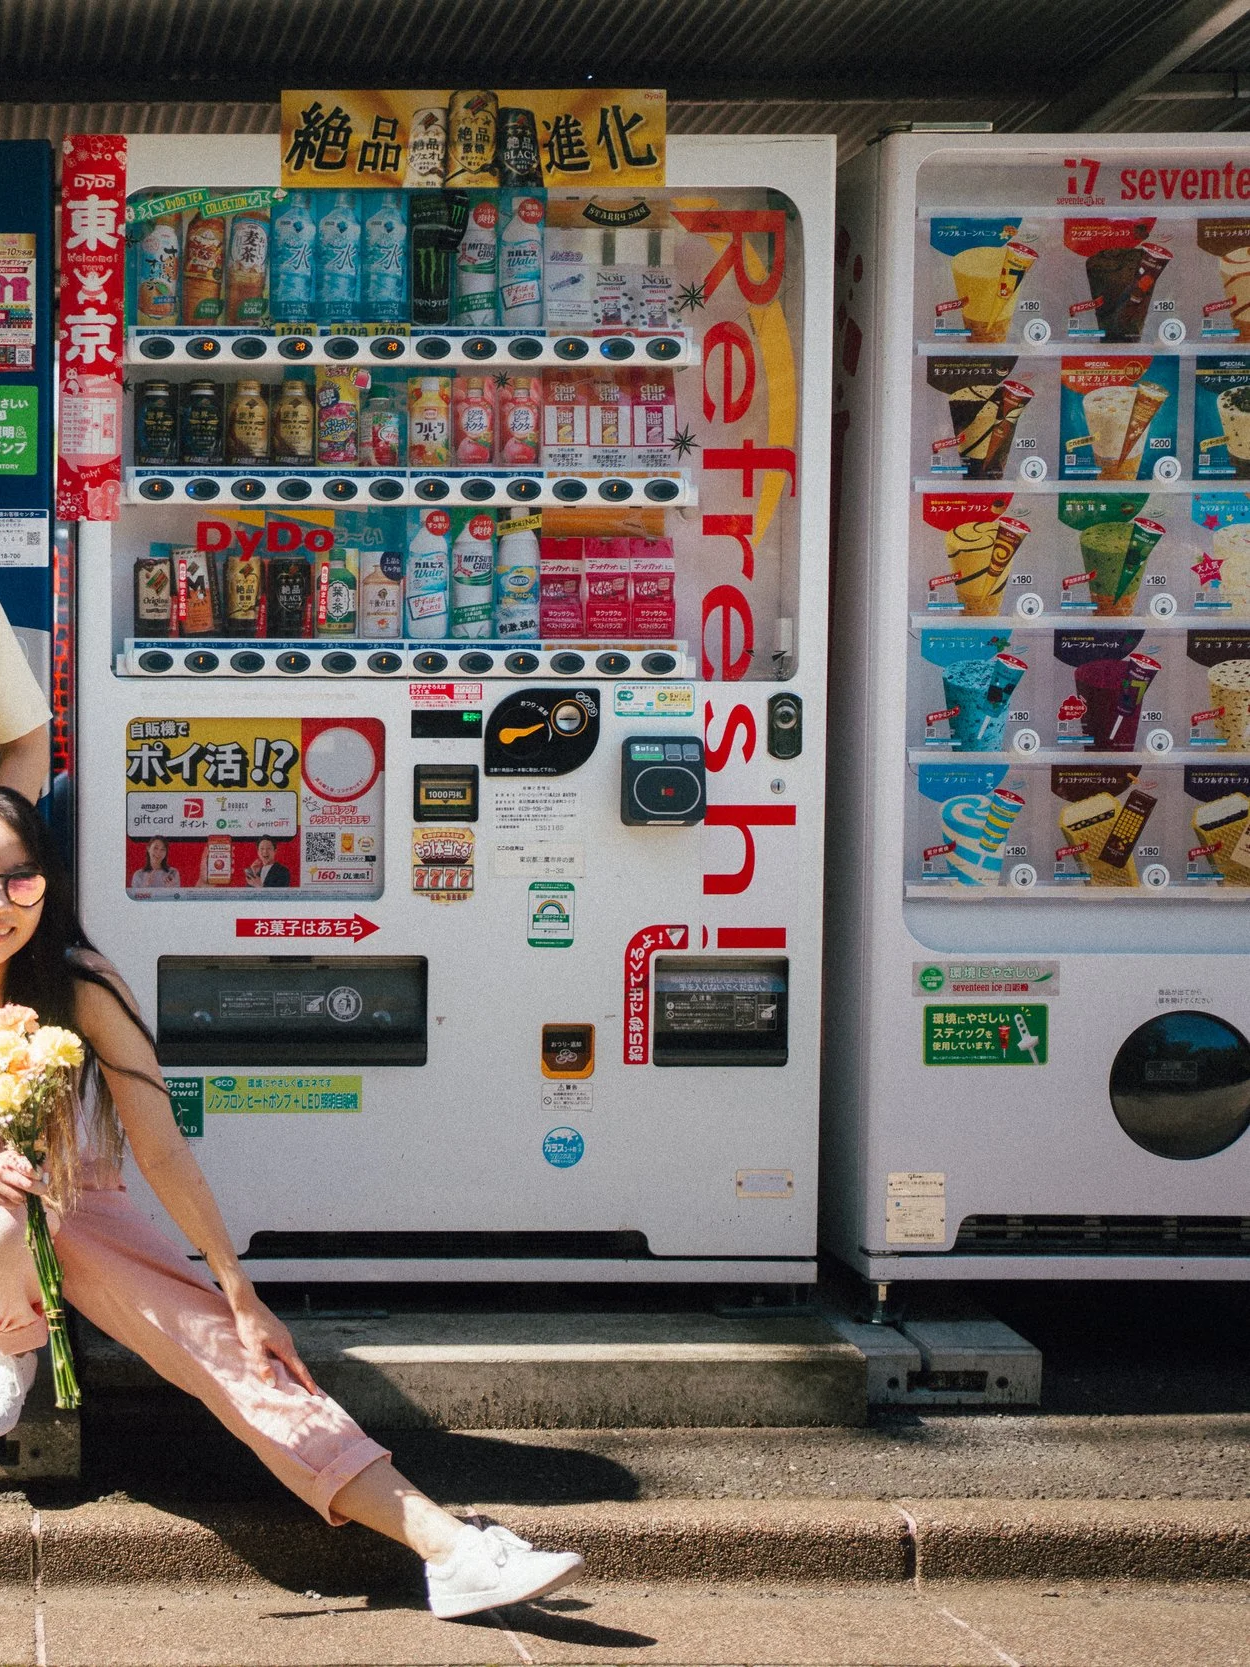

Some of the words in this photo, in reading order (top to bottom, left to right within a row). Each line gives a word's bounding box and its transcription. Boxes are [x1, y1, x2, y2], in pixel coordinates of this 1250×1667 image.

[284, 101, 403, 174] 絶品
[457, 126, 491, 142] 絶品
[541, 104, 659, 174] 進化
[503, 151, 538, 161] BLACK
[74, 174, 116, 191] DyDo
[189, 191, 204, 203] TEA
[205, 196, 249, 214] COLLECTION
[66, 194, 120, 250] 東
[937, 230, 997, 238] ワッフルコーンバニラ
[1071, 230, 1131, 238] ワッフルコーンショコラ
[241, 231, 260, 264] 麦茶
[286, 244, 313, 270] 水
[329, 244, 357, 270] 水
[375, 244, 403, 270] 水
[507, 257, 538, 267] Water
[597, 272, 626, 284] Noir
[642, 273, 671, 285] Noir
[1020, 301, 1040, 311] ¥180
[1154, 301, 1174, 311] ¥180
[64, 307, 118, 364] 京
[934, 367, 993, 376] 生チョコティラミス
[1068, 374, 1126, 383] 贅沢マカダミア
[554, 384, 575, 394] chip
[640, 383, 666, 394] chip
[554, 393, 576, 401] star
[599, 393, 620, 402] star
[640, 393, 666, 401] star
[415, 422, 445, 434] フルーツ
[463, 422, 488, 432] ネクター
[510, 422, 534, 432] ネクター
[1016, 439, 1036, 448] ¥180
[1150, 439, 1170, 449] ¥200
[930, 505, 989, 513] カスタードプリン
[472, 526, 492, 537] 爽快
[196, 521, 335, 562] DyDo
[414, 561, 445, 569] カルピス
[1196, 562, 1220, 573] 大人気
[414, 569, 444, 579] Water
[1013, 575, 1032, 584] ¥180
[1147, 575, 1166, 585] ¥180
[280, 584, 301, 595] 絶品
[331, 585, 345, 614] 葉の茶
[929, 639, 986, 649] チョコミント
[1061, 640, 1120, 649] グレープシャーベット
[1009, 711, 1029, 721] ¥180
[1142, 711, 1163, 721] ¥180
[130, 721, 189, 739] 自販機で
[126, 738, 297, 788] ポイ活!?
[926, 775, 983, 785] ソーダフロート
[1058, 775, 1118, 785] チョコナッツバニラモナカ
[428, 789, 463, 800] 1000円札
[140, 803, 168, 812] amazon
[134, 814, 152, 827] gift
[152, 815, 174, 825] card
[179, 820, 208, 828] ポイント
[256, 819, 290, 828] petitGIFT
[414, 841, 475, 859] もう1本当たる!
[1006, 846, 1027, 857] ¥180
[1139, 846, 1160, 857] ¥180
[253, 920, 364, 937] お菓子はあちら
[949, 965, 1040, 980] 環境にやさしい
[952, 982, 990, 992] seventeen
[992, 982, 1002, 992] ice
[932, 1012, 1011, 1026] 環境にやさしい
[932, 1027, 994, 1040] スティックを
[931, 1040, 996, 1052] 使用しています。
[166, 1079, 199, 1089] Green
[215, 1078, 234, 1087] eco
[246, 1078, 332, 1088] 環境にやさしく省エネです
